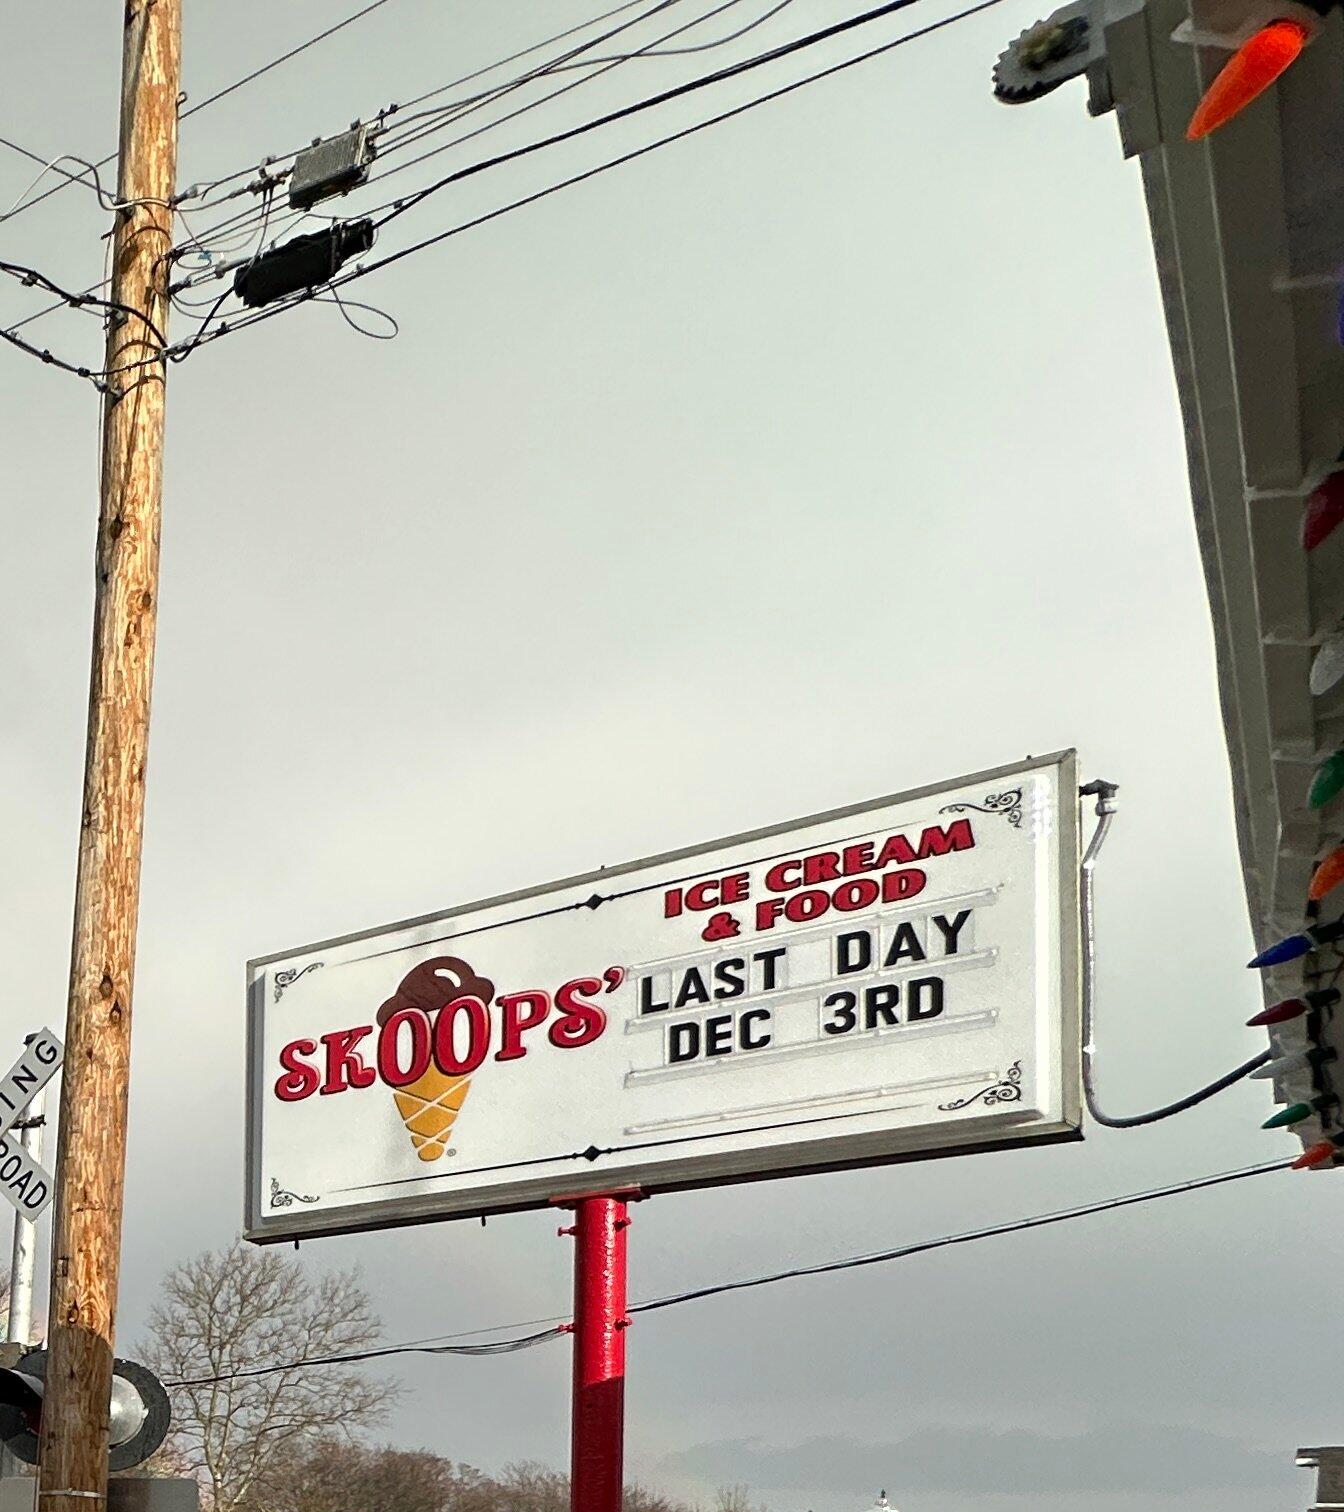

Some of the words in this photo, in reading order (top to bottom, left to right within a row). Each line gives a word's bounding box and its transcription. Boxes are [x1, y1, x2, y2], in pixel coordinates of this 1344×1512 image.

[664, 872, 750, 918] ICE
[765, 818, 976, 893] CREAM
[701, 912, 741, 942] &
[756, 868, 927, 931] FOOD
[640, 948, 786, 1015] LAST
[836, 909, 973, 975] DAY
[668, 1008, 772, 1063] DEC
[823, 976, 944, 1034] 3RD
